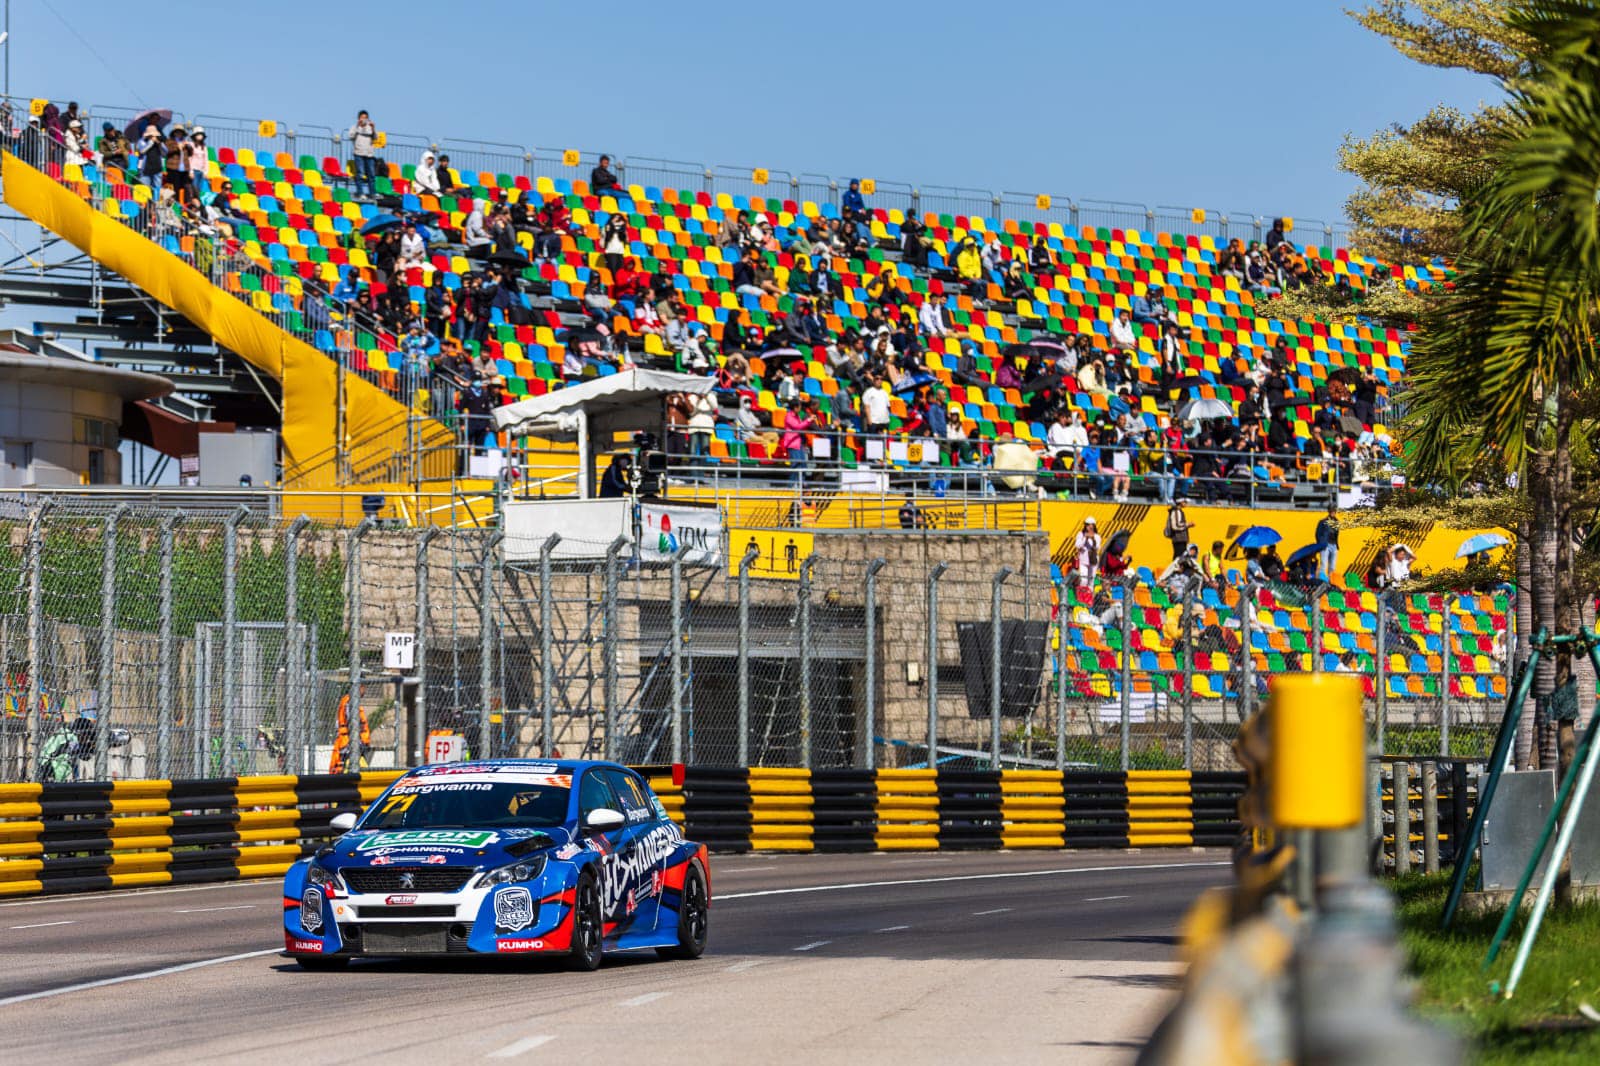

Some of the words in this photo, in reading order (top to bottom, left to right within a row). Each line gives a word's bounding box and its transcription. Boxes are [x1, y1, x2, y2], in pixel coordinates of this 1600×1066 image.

[391, 636, 412, 647] MP
[396, 650, 403, 665] 1
[436, 741, 450, 761] FP
[391, 783, 493, 796] Bargwanna
[381, 794, 418, 814] 71
[400, 846, 464, 854] HANGCHA
[498, 940, 543, 950] KUMHO
